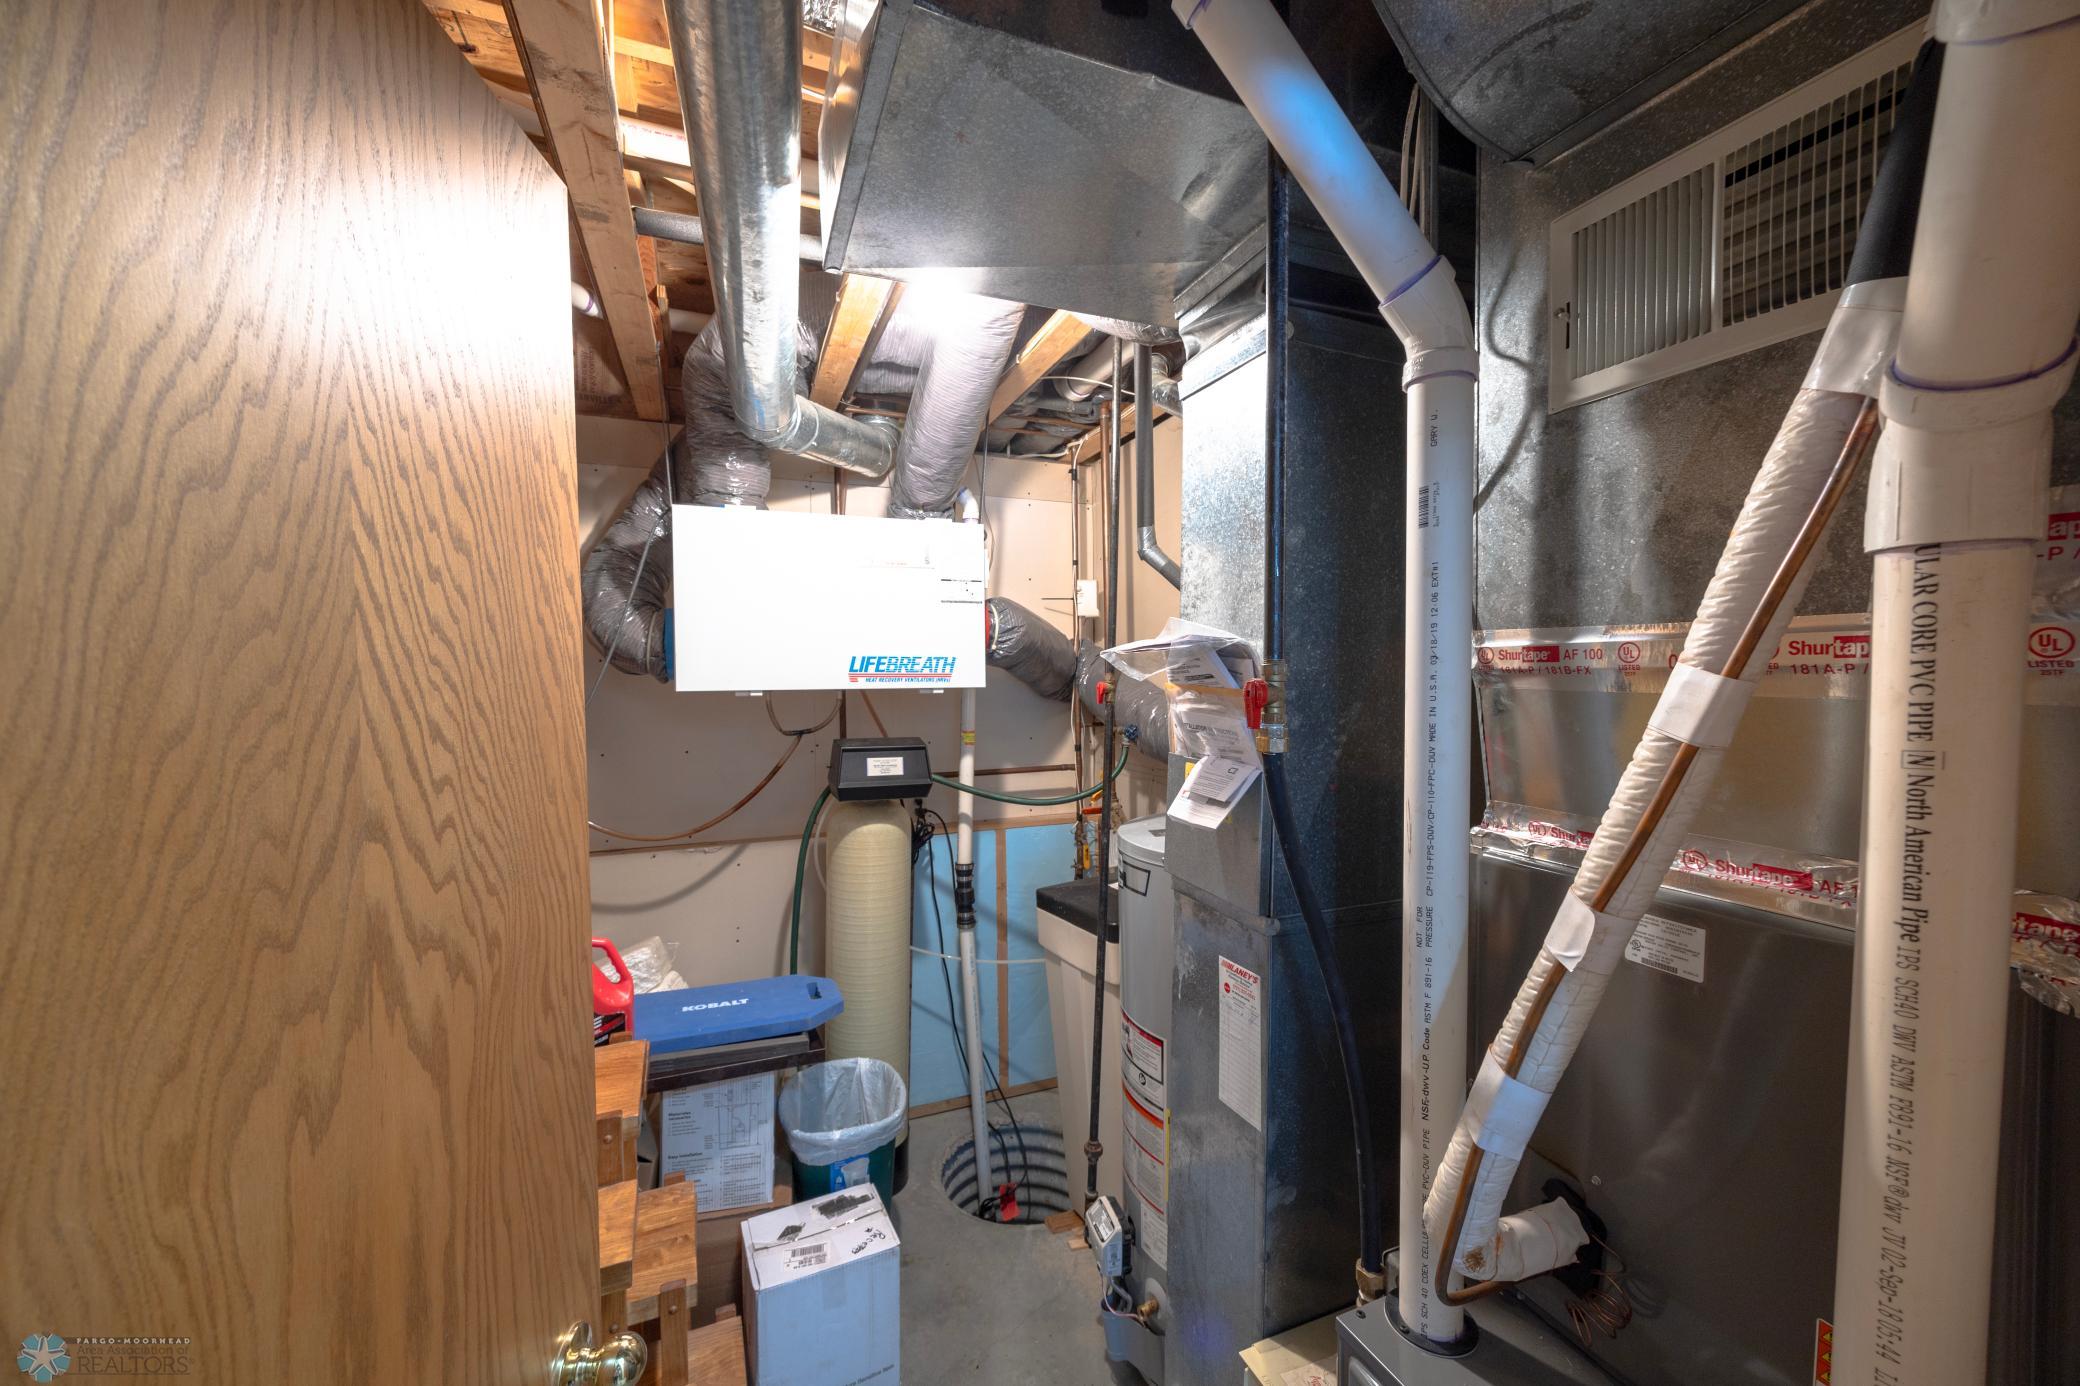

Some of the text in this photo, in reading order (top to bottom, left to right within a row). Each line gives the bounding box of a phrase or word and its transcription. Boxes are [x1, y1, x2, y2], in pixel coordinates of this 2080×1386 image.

[1430, 426, 1439, 447] GARY
[1913, 543, 1941, 597] ULAR
[1911, 601, 1940, 654] CORE
[1563, 650, 1578, 660] AF
[1584, 648, 1603, 660] 100
[1788, 638, 1870, 659] Shurtap
[848, 656, 957, 673] LIFEBREATH
[1791, 664, 1856, 675] 181A-P
[1908, 659, 1937, 696] PVC
[2028, 660, 2075, 668] LISTED
[1429, 706, 1436, 717] IN
[1907, 701, 1935, 742] PIPE
[1428, 723, 1436, 742] MADE
[1906, 773, 1935, 820] North
[1716, 859, 1795, 888] Shurtape
[1902, 825, 1932, 902] American
[1425, 906, 1433, 948] PRESSURE
[1893, 906, 1929, 943] Pipe
[1424, 957, 1432, 988] 891-16
[1896, 945, 1920, 971] IPS
[681, 998, 749, 1012] KOBALT
[1893, 977, 1920, 1020] SCH40
[1422, 1028, 1430, 1050] Code
[1892, 1024, 1917, 1053] DWV
[1890, 1054, 1915, 1092] ASTM
[1422, 1127, 1430, 1149] PIPE
[1886, 1094, 1915, 1155] F891-16
[1421, 1288, 1428, 1299] 40
